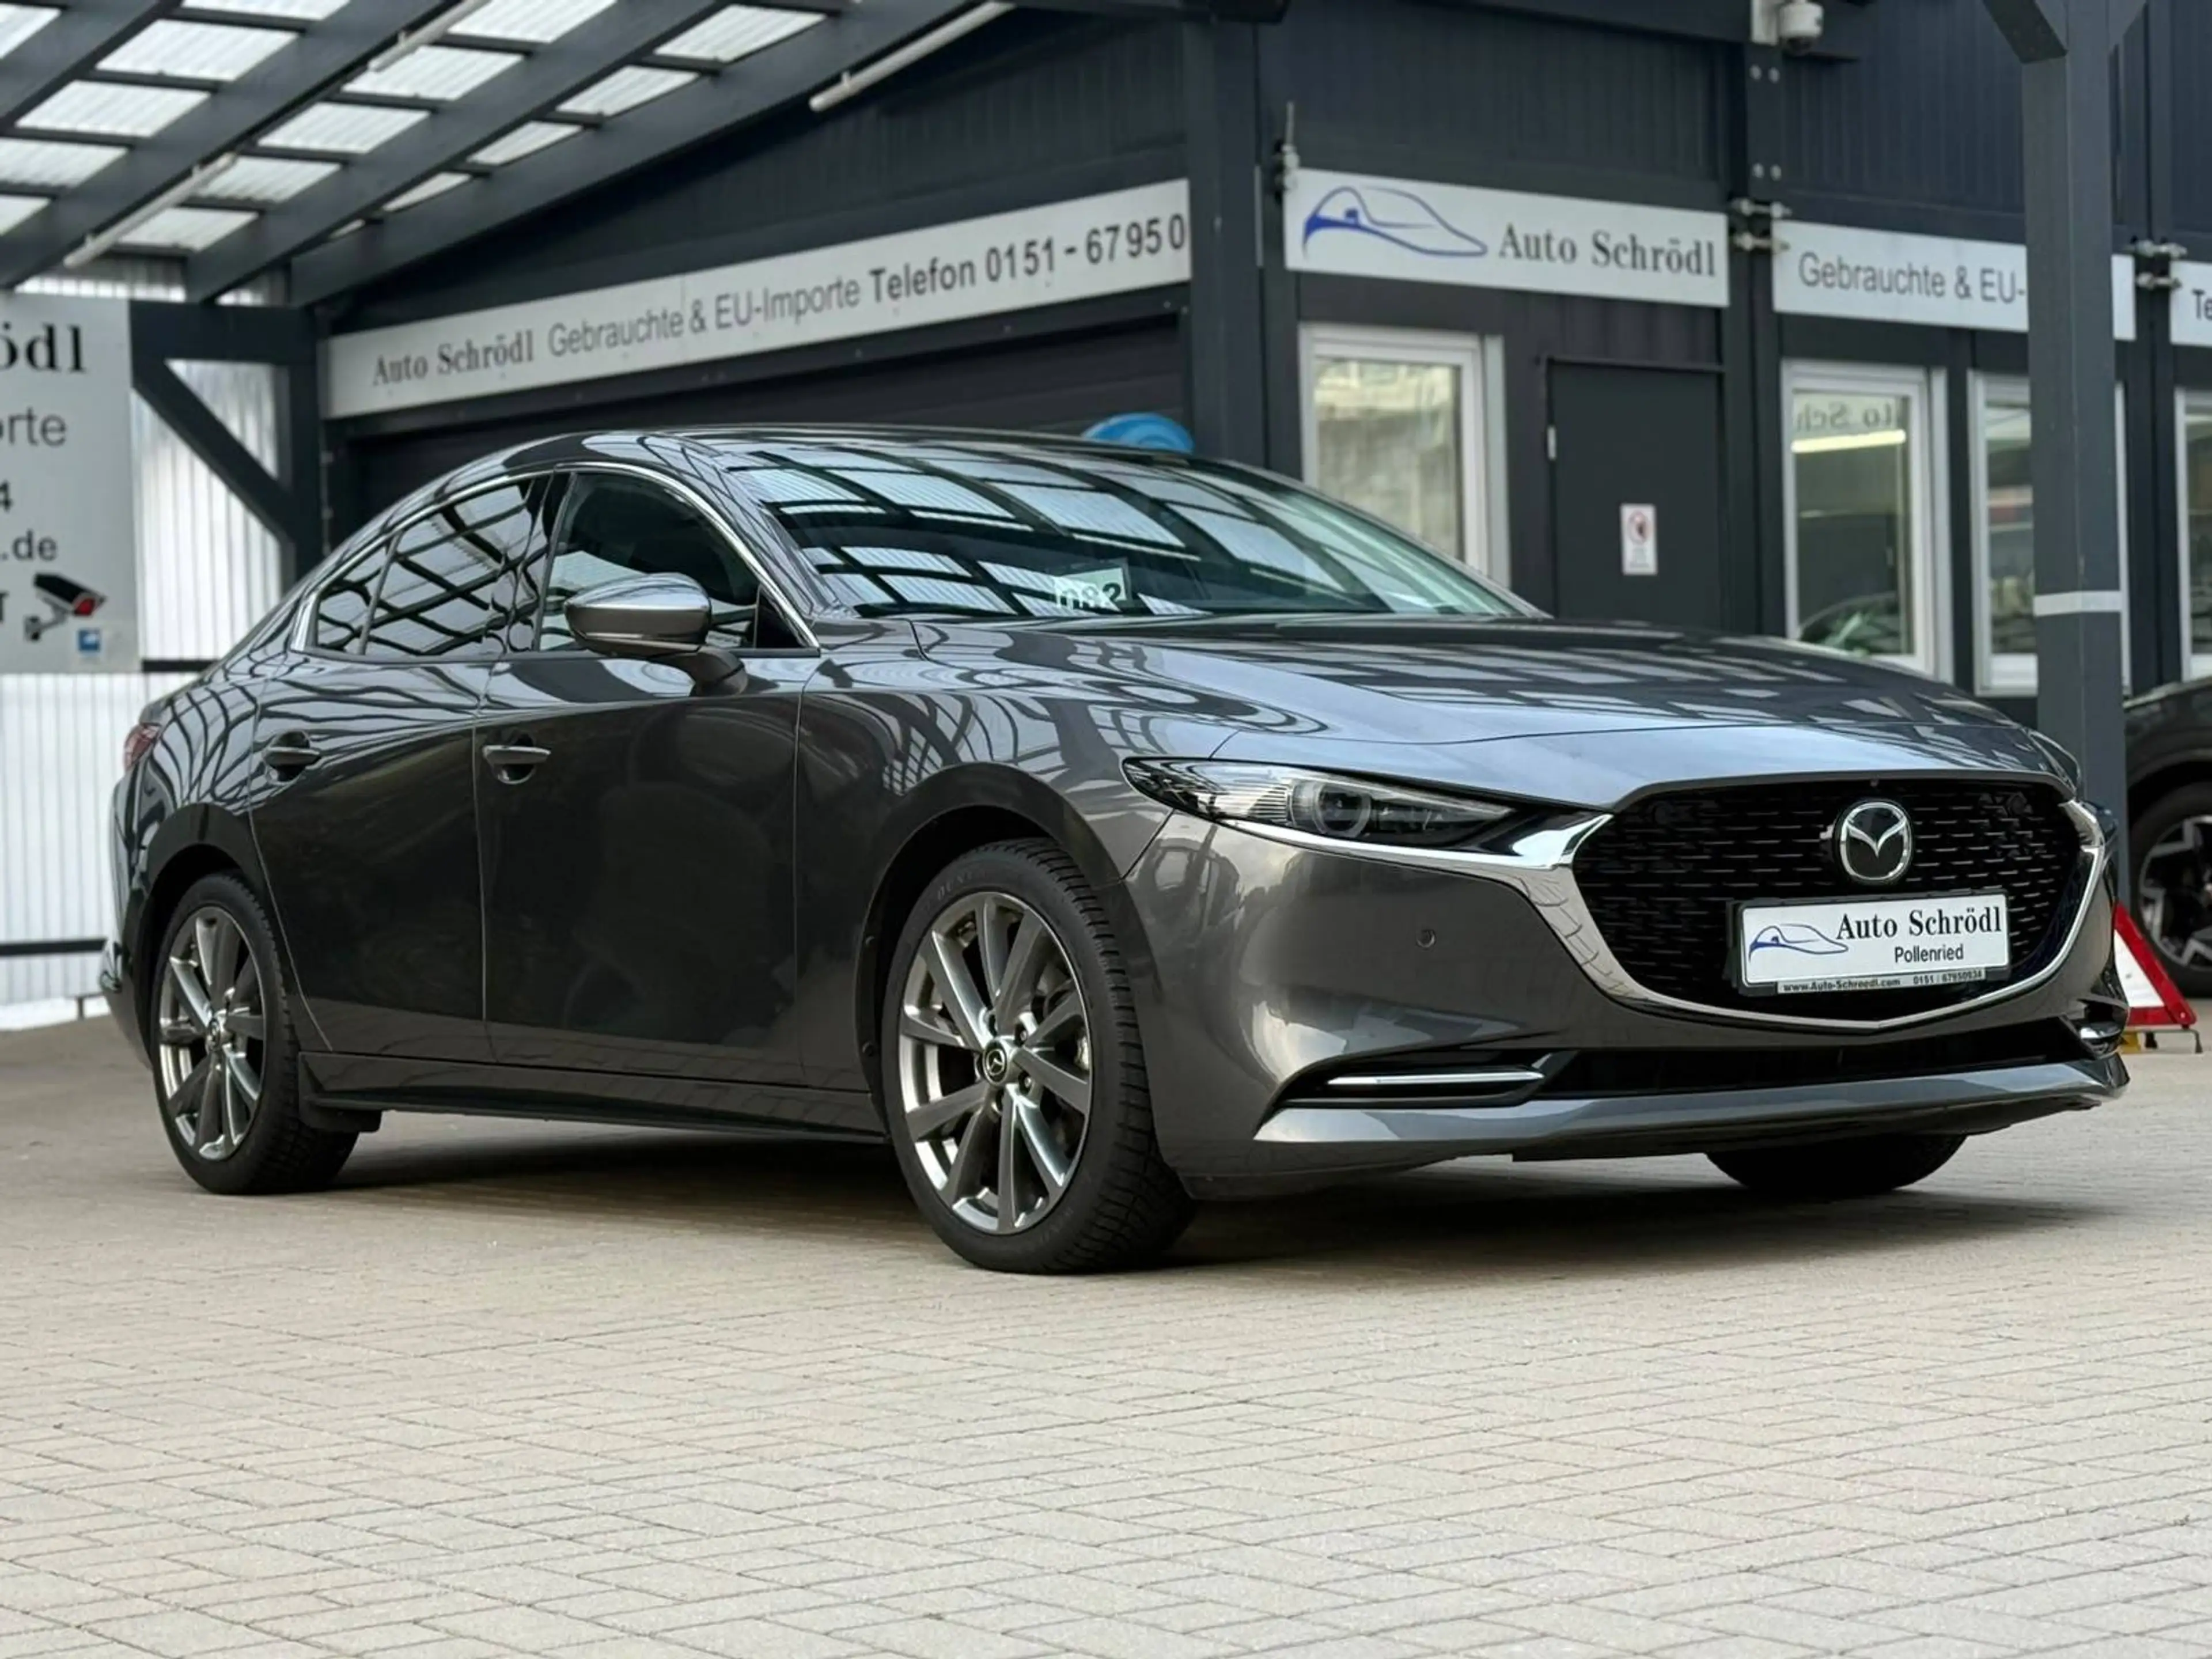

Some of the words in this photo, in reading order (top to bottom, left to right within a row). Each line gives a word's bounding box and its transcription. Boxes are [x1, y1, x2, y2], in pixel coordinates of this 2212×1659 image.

[1499, 222, 1578, 264] Auto
[1591, 229, 1715, 277] Schrödl
[1798, 251, 1946, 298] Gebrauchte
[1955, 266, 1972, 300] &
[373, 353, 429, 385] Auto
[436, 329, 535, 375] Schrödl
[548, 308, 684, 357] Gebrauchte
[689, 299, 707, 335] &
[715, 275, 861, 330] EU-Importe
[869, 257, 976, 304] Telefon
[986, 236, 1054, 283] 0151
[0, 406, 67, 447] rte
[1836, 913, 1898, 940] Auto
[1909, 906, 2002, 937] Schrödl
[1894, 944, 1964, 963] Pollenried
